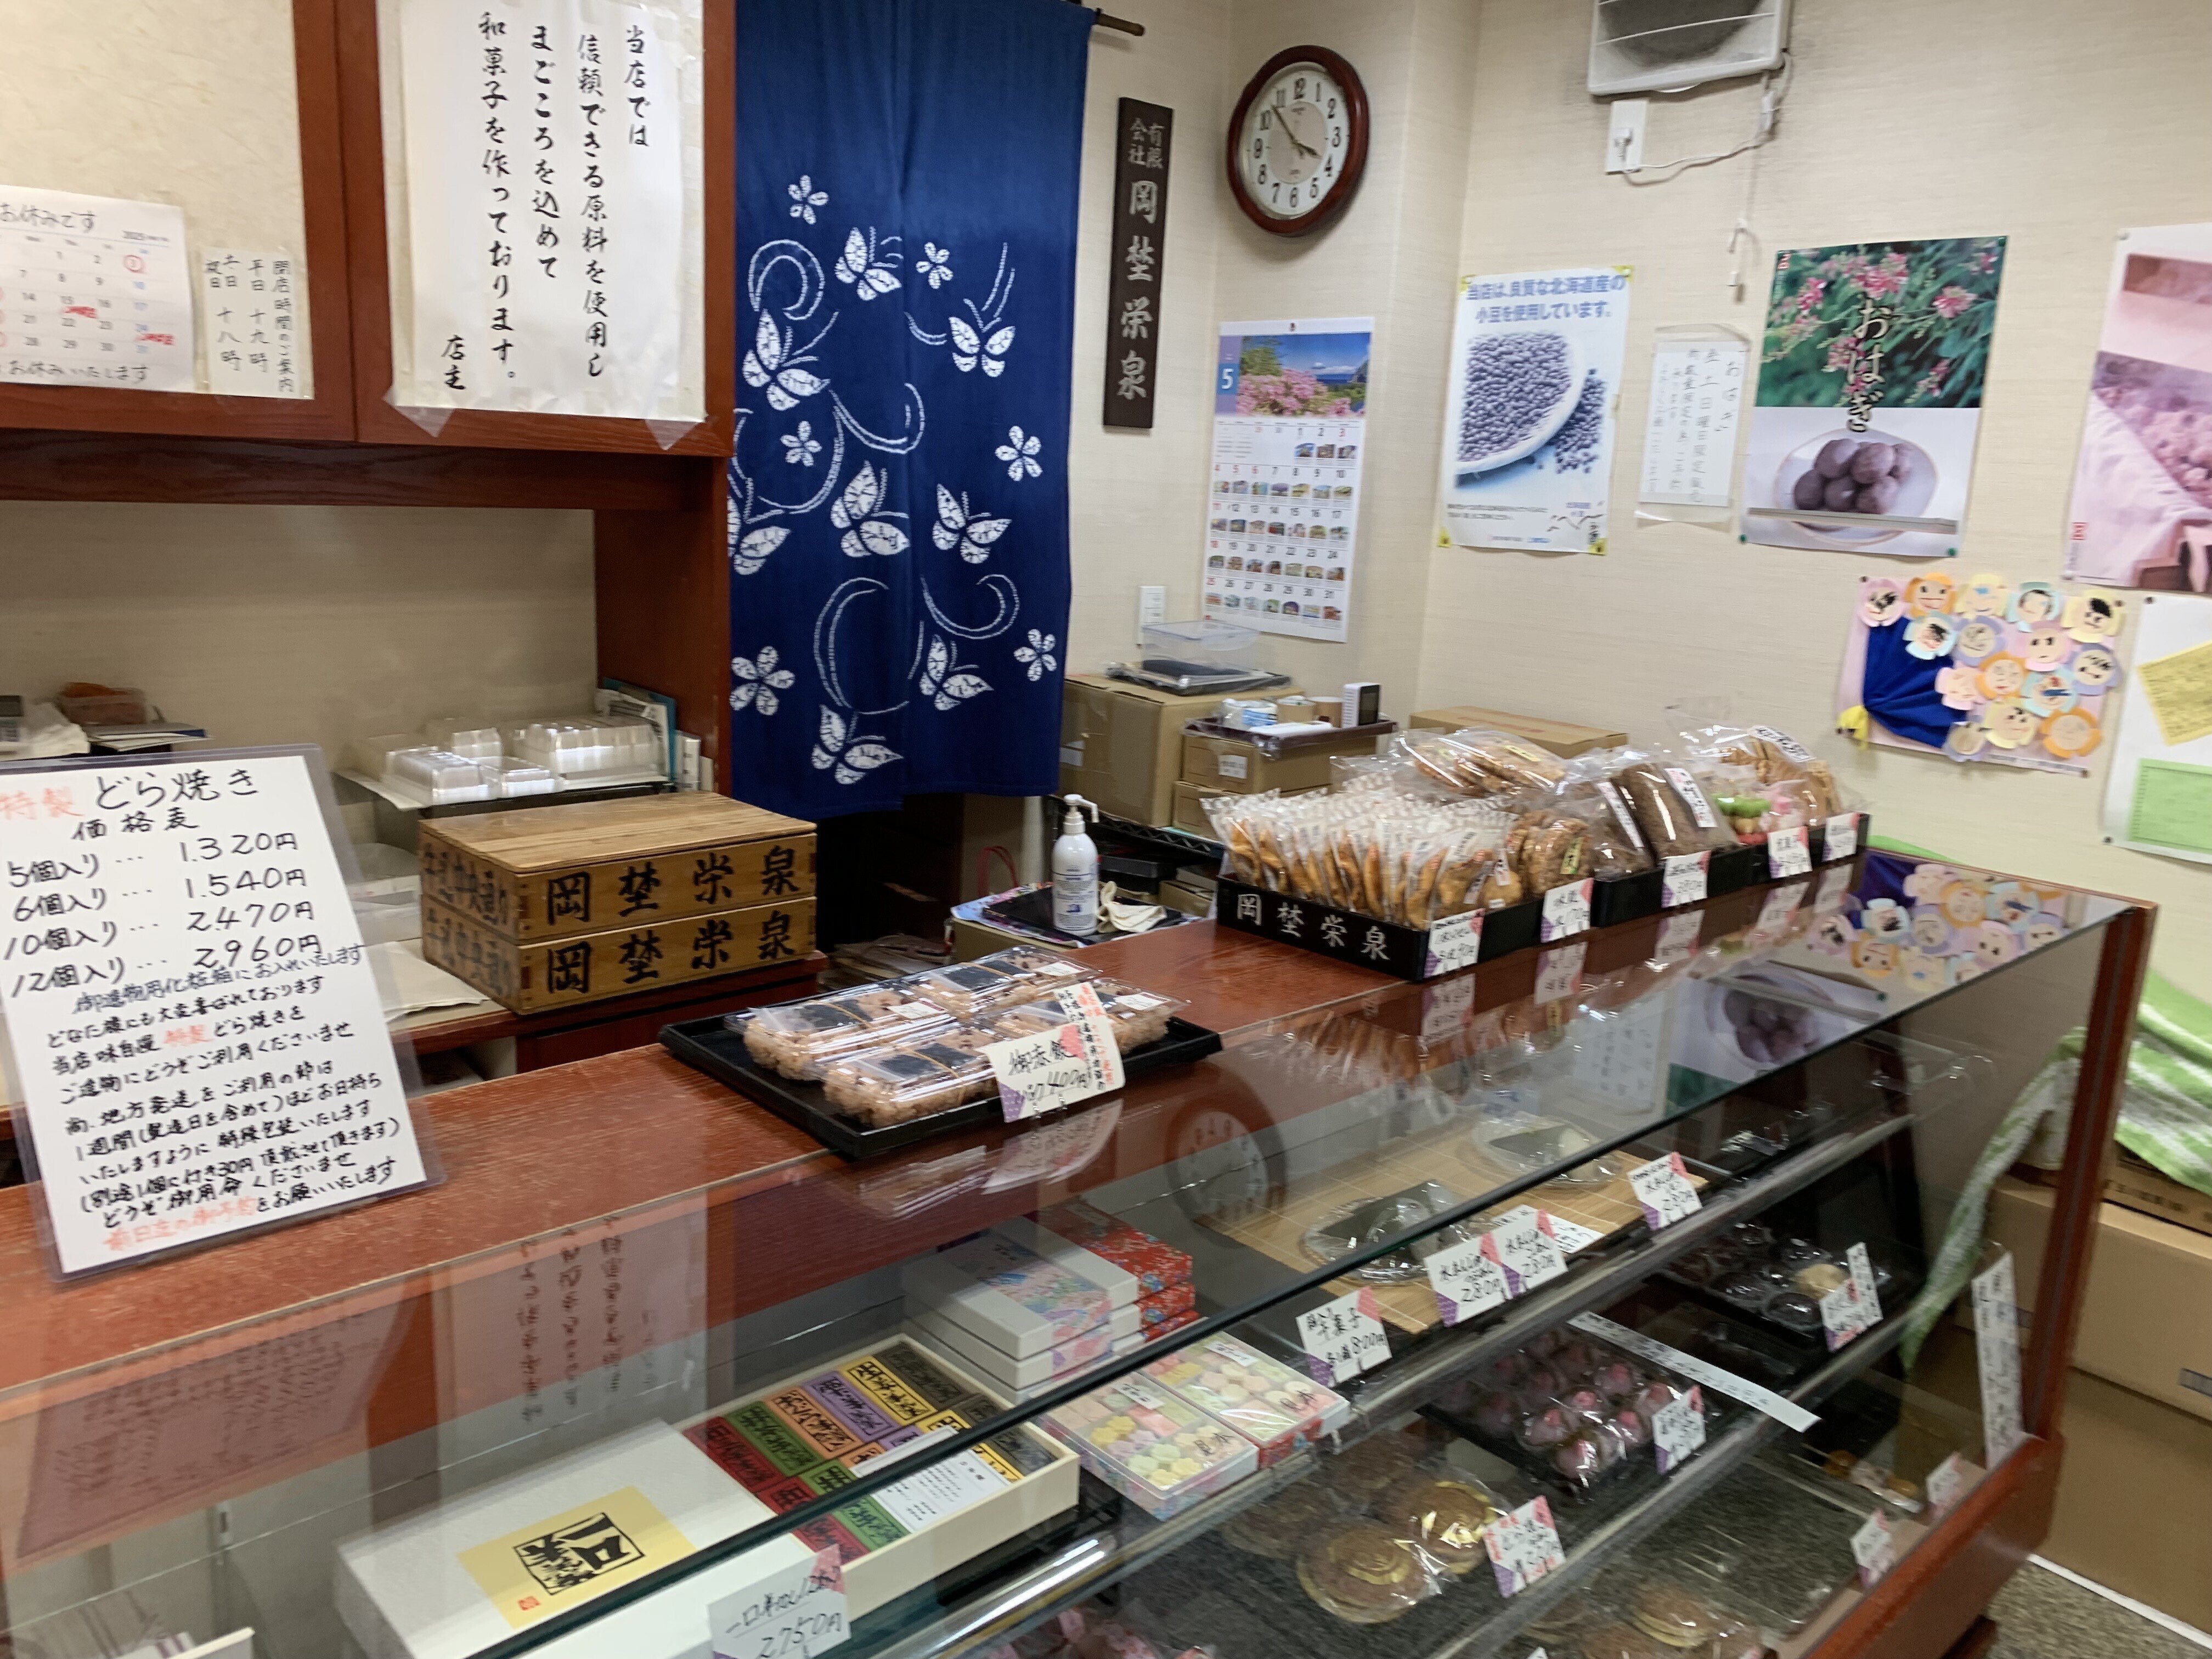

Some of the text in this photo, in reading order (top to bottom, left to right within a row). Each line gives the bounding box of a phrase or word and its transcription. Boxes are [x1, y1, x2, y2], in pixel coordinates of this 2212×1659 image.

[624, 24, 650, 148] 当店では
[531, 26, 561, 279] まごころを込めて
[478, 12, 517, 379] 和菓子を作っております。
[577, 33, 609, 378] 信頼できる原料を使用し
[248, 259, 265, 291] 平日
[441, 335, 466, 391] 店主
[1221, 367, 1234, 390] 5
[1846, 297, 1894, 433] おはぎ
[71, 806, 199, 841] 価格表
[94, 768, 258, 811] どら焼き
[547, 845, 800, 926] 岡埜栄泉
[547, 910, 795, 995] 岡埜栄泉
[1235, 893, 1390, 961] 岡埜栄泉
